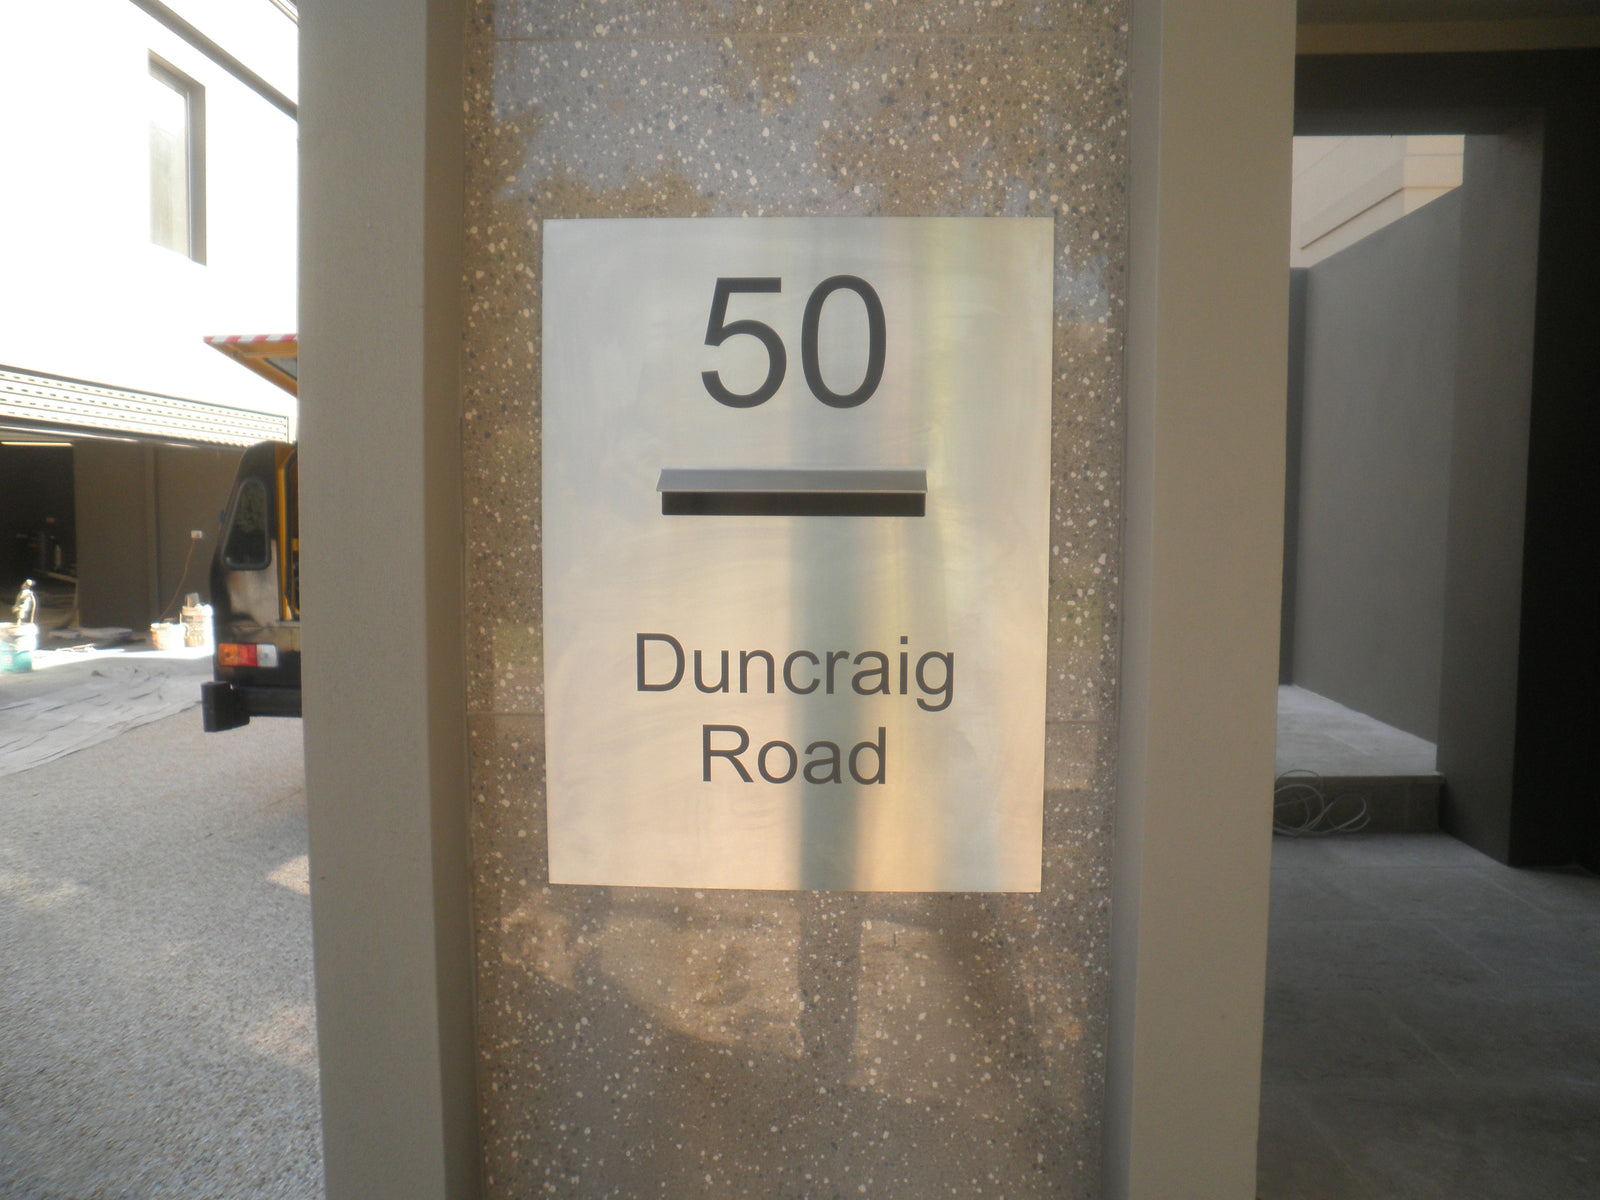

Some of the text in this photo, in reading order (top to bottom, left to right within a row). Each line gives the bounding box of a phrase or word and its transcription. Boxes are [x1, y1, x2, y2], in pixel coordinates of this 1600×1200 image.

[702, 275, 887, 409] 50
[636, 634, 955, 712] Duncraig
[702, 725, 886, 786] Road
